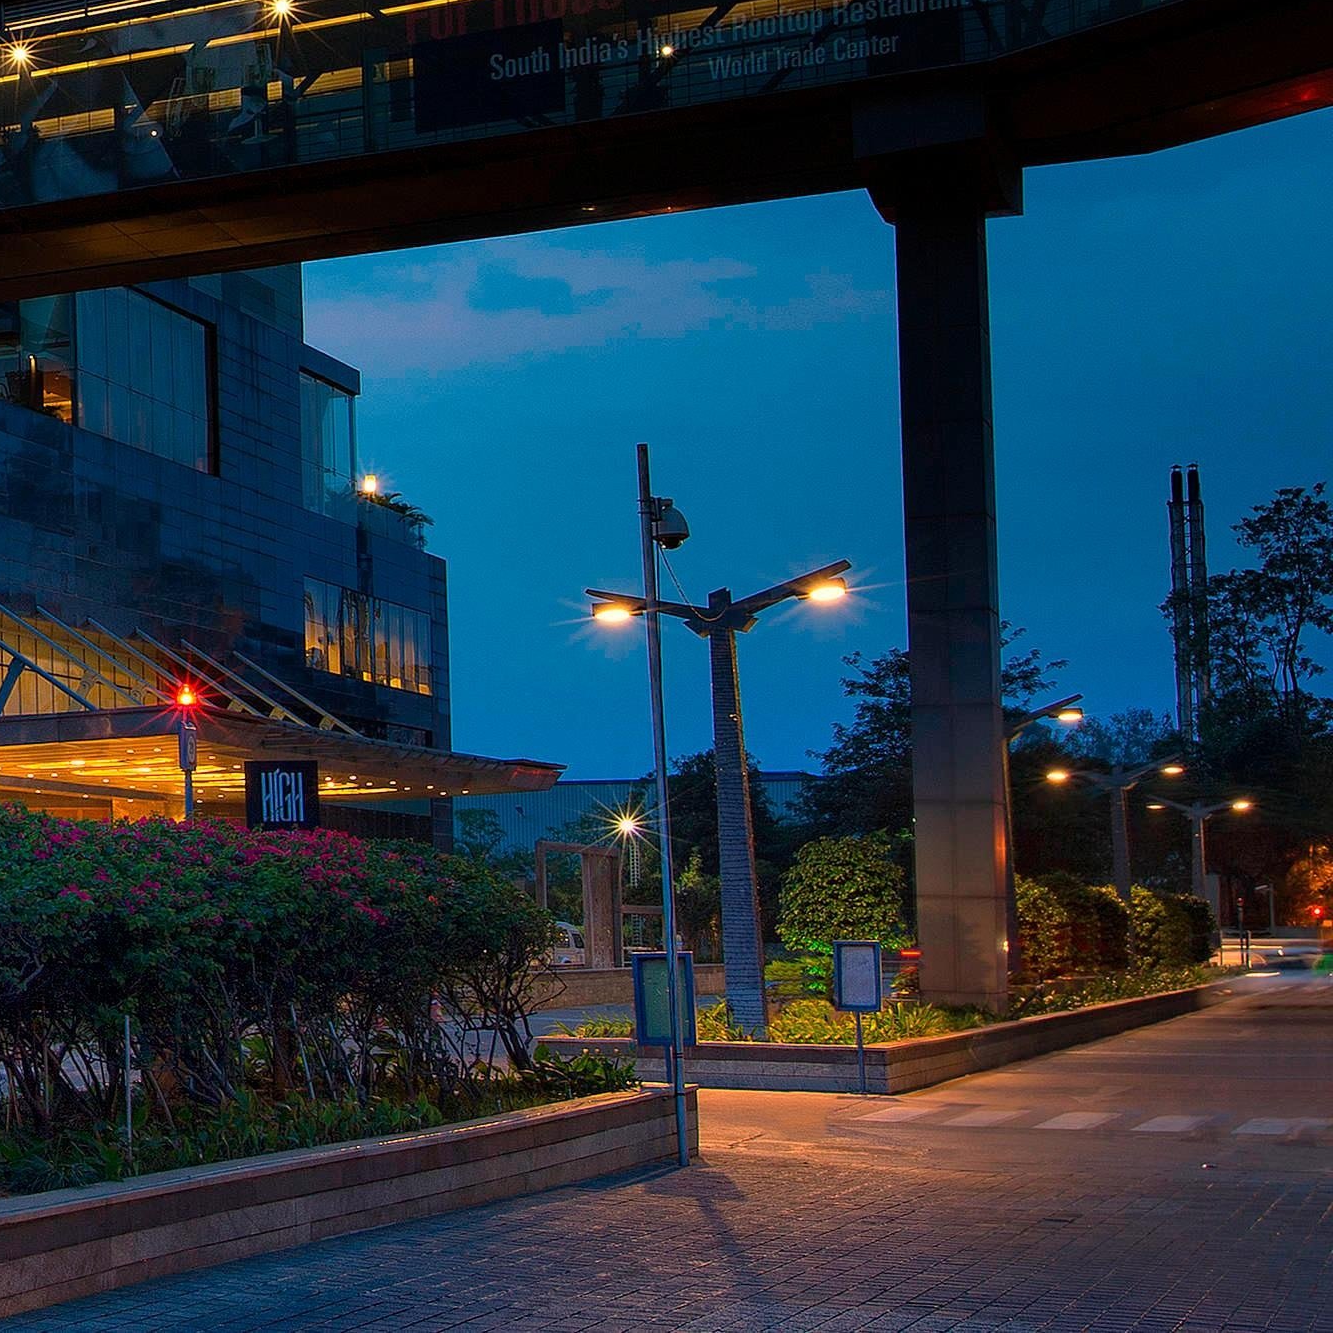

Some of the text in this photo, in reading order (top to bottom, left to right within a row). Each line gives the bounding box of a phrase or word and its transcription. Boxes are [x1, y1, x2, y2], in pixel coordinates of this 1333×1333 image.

[489, 45, 550, 81] South
[558, 32, 629, 70] India's
[637, 22, 725, 68] Highest
[732, 7, 823, 42] Rooftop
[708, 32, 900, 80] World Trade Center
[260, 768, 305, 822] HIGH
